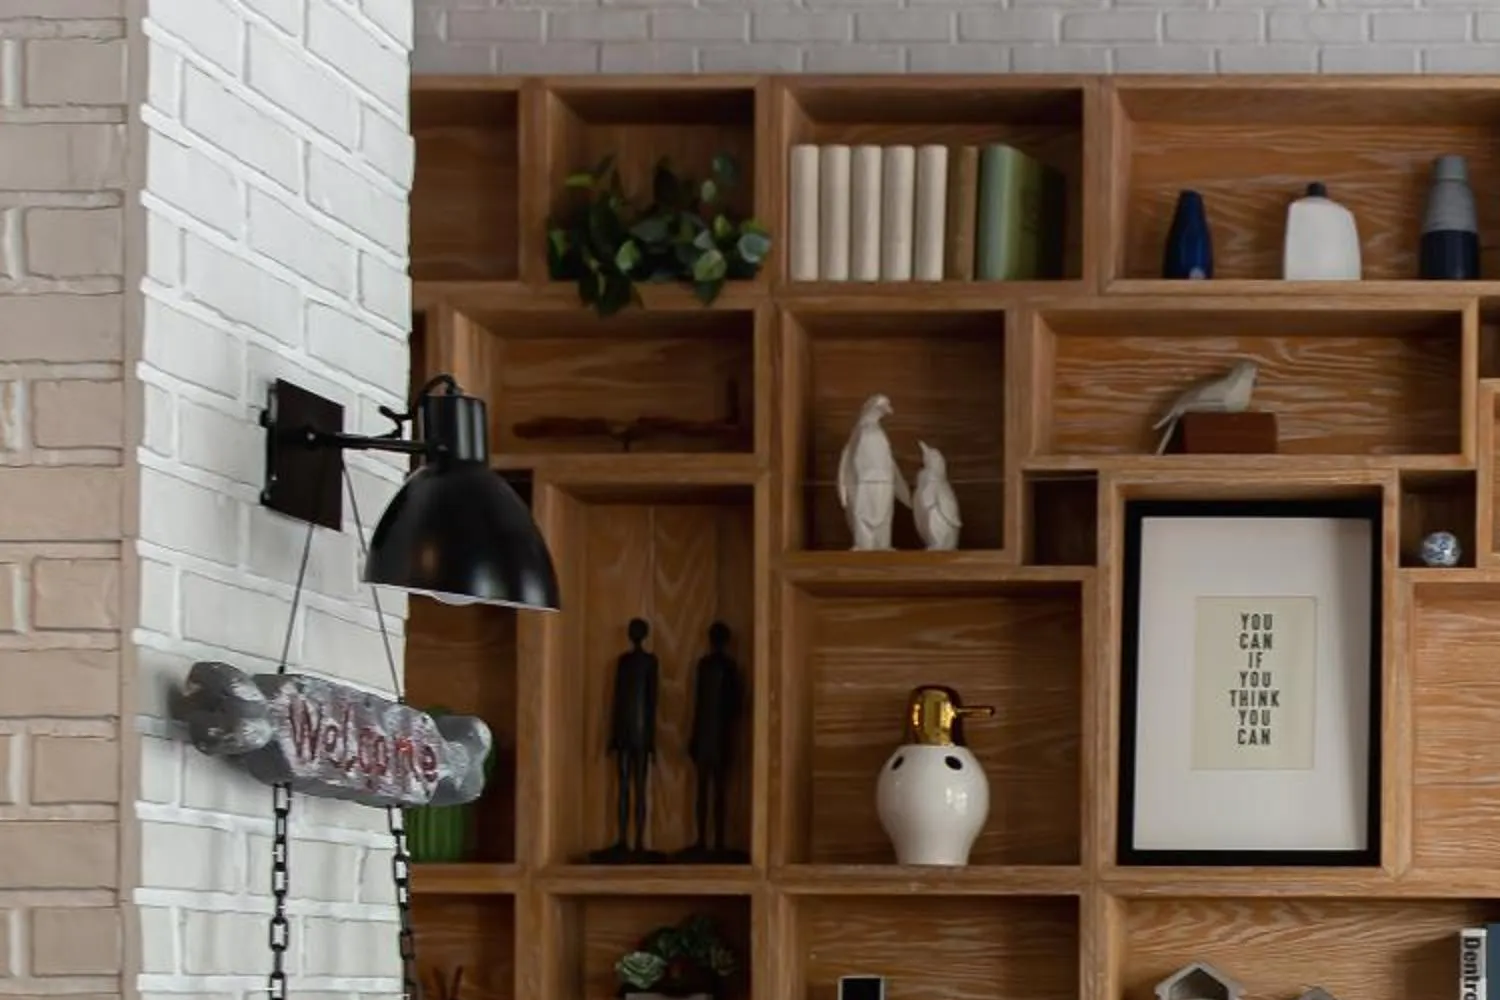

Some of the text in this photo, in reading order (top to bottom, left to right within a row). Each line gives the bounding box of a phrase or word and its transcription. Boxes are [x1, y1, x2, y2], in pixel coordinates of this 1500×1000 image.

[1240, 613, 1273, 630] YOU
[1239, 633, 1273, 650] CAN
[1248, 652, 1263, 669] IF
[1239, 671, 1272, 688] YOU
[1229, 690, 1280, 707] THINK
[1238, 710, 1271, 726] YOU
[288, 696, 439, 782] Welcome
[1237, 728, 1271, 745] CAN
